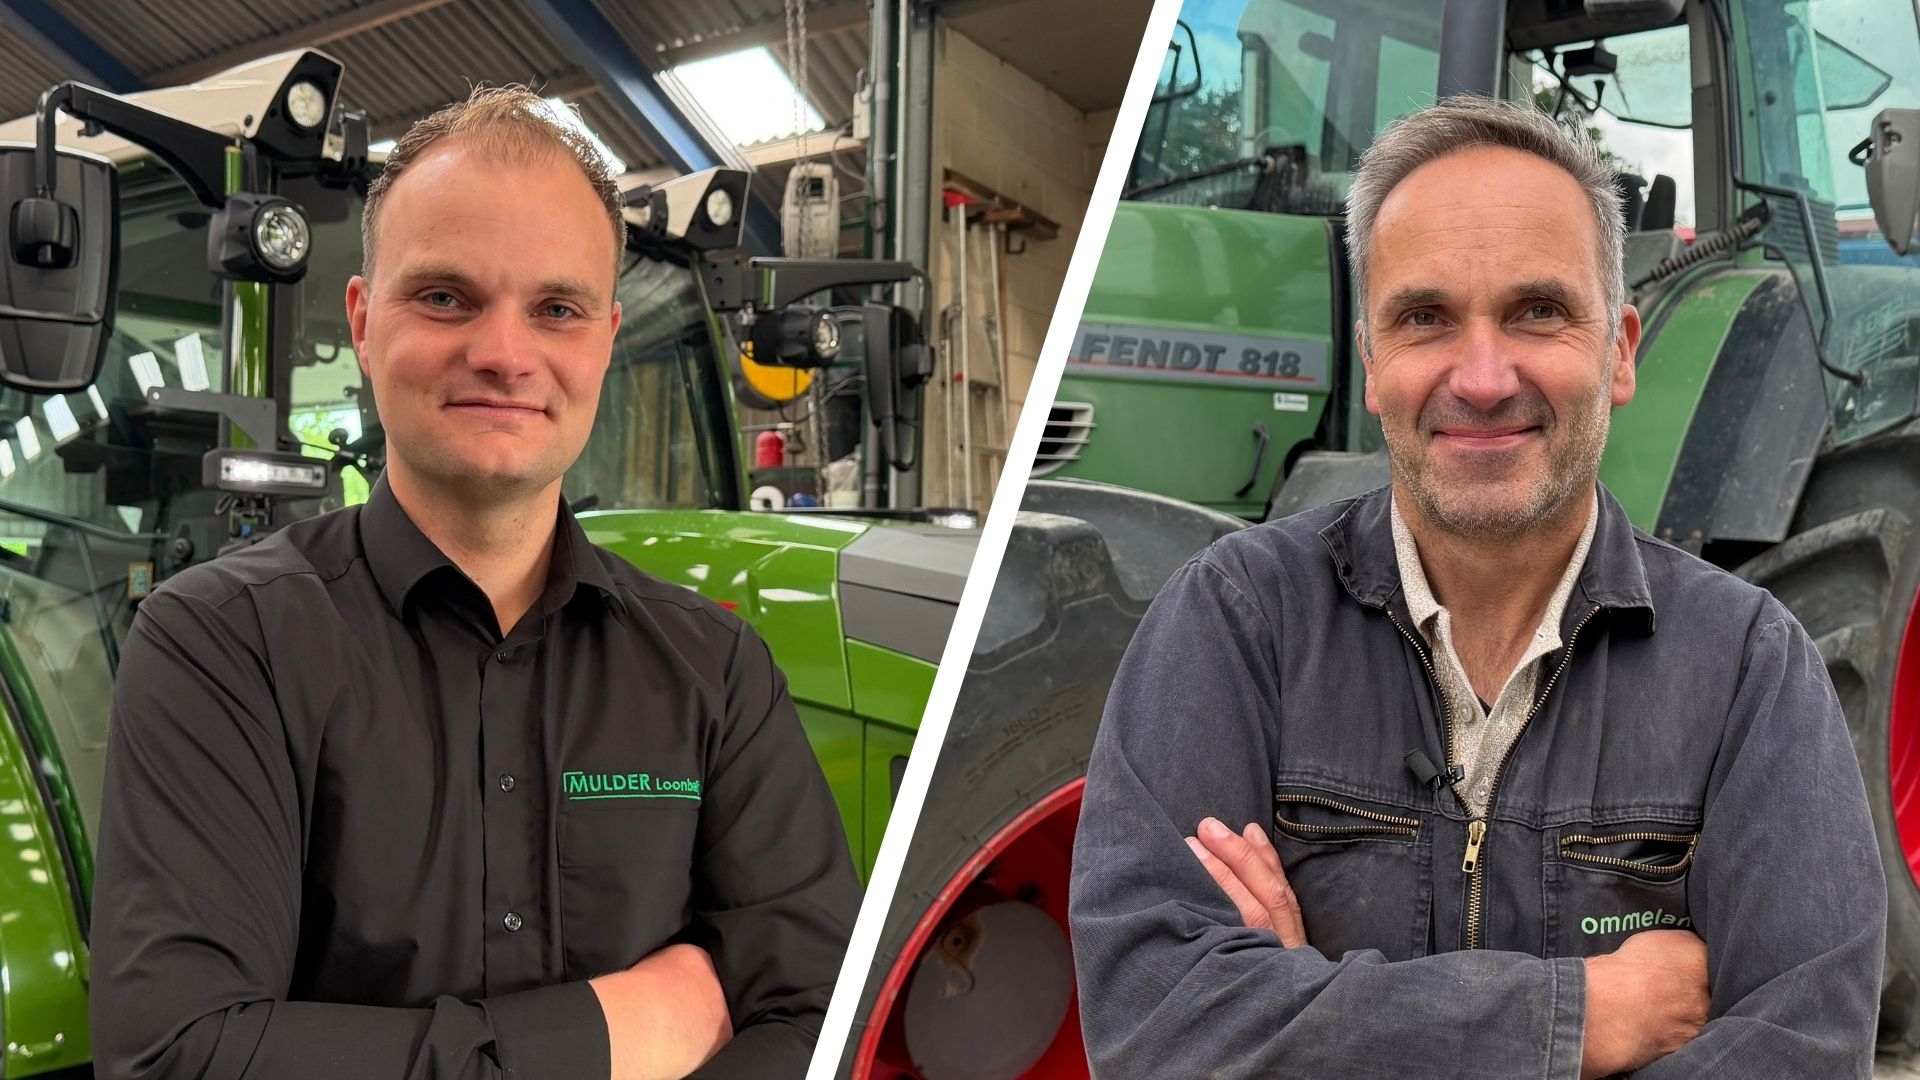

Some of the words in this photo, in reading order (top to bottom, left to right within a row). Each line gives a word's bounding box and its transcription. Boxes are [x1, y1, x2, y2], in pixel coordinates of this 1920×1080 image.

[1080, 333, 1226, 372] FENDT
[1238, 347, 1301, 377] 818
[568, 773, 651, 793] MULDER
